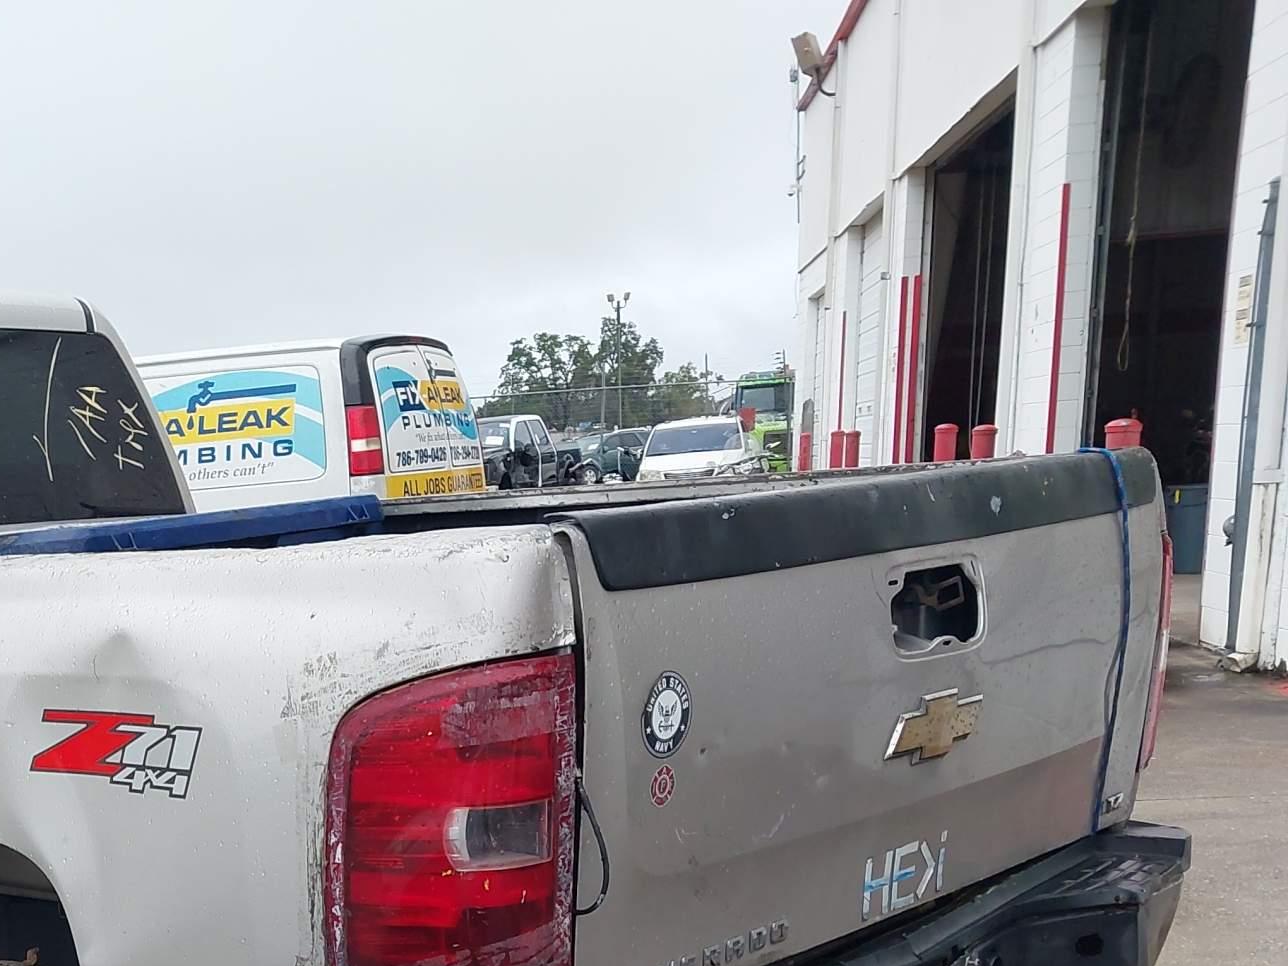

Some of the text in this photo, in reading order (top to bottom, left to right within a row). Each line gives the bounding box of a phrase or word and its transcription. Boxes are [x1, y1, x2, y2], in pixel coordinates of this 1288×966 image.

[396, 381, 420, 406] FIX
[439, 385, 465, 404] LEAK
[165, 406, 291, 438] A LEAK
[401, 411, 471, 431] PLUMBING
[189, 467, 229, 481] others
[403, 479, 421, 497] ALL
[423, 477, 446, 496] JOBS
[646, 677, 690, 712] UNITED STATES
[30, 708, 203, 777] Z71
[654, 738, 675, 753] NAVY
